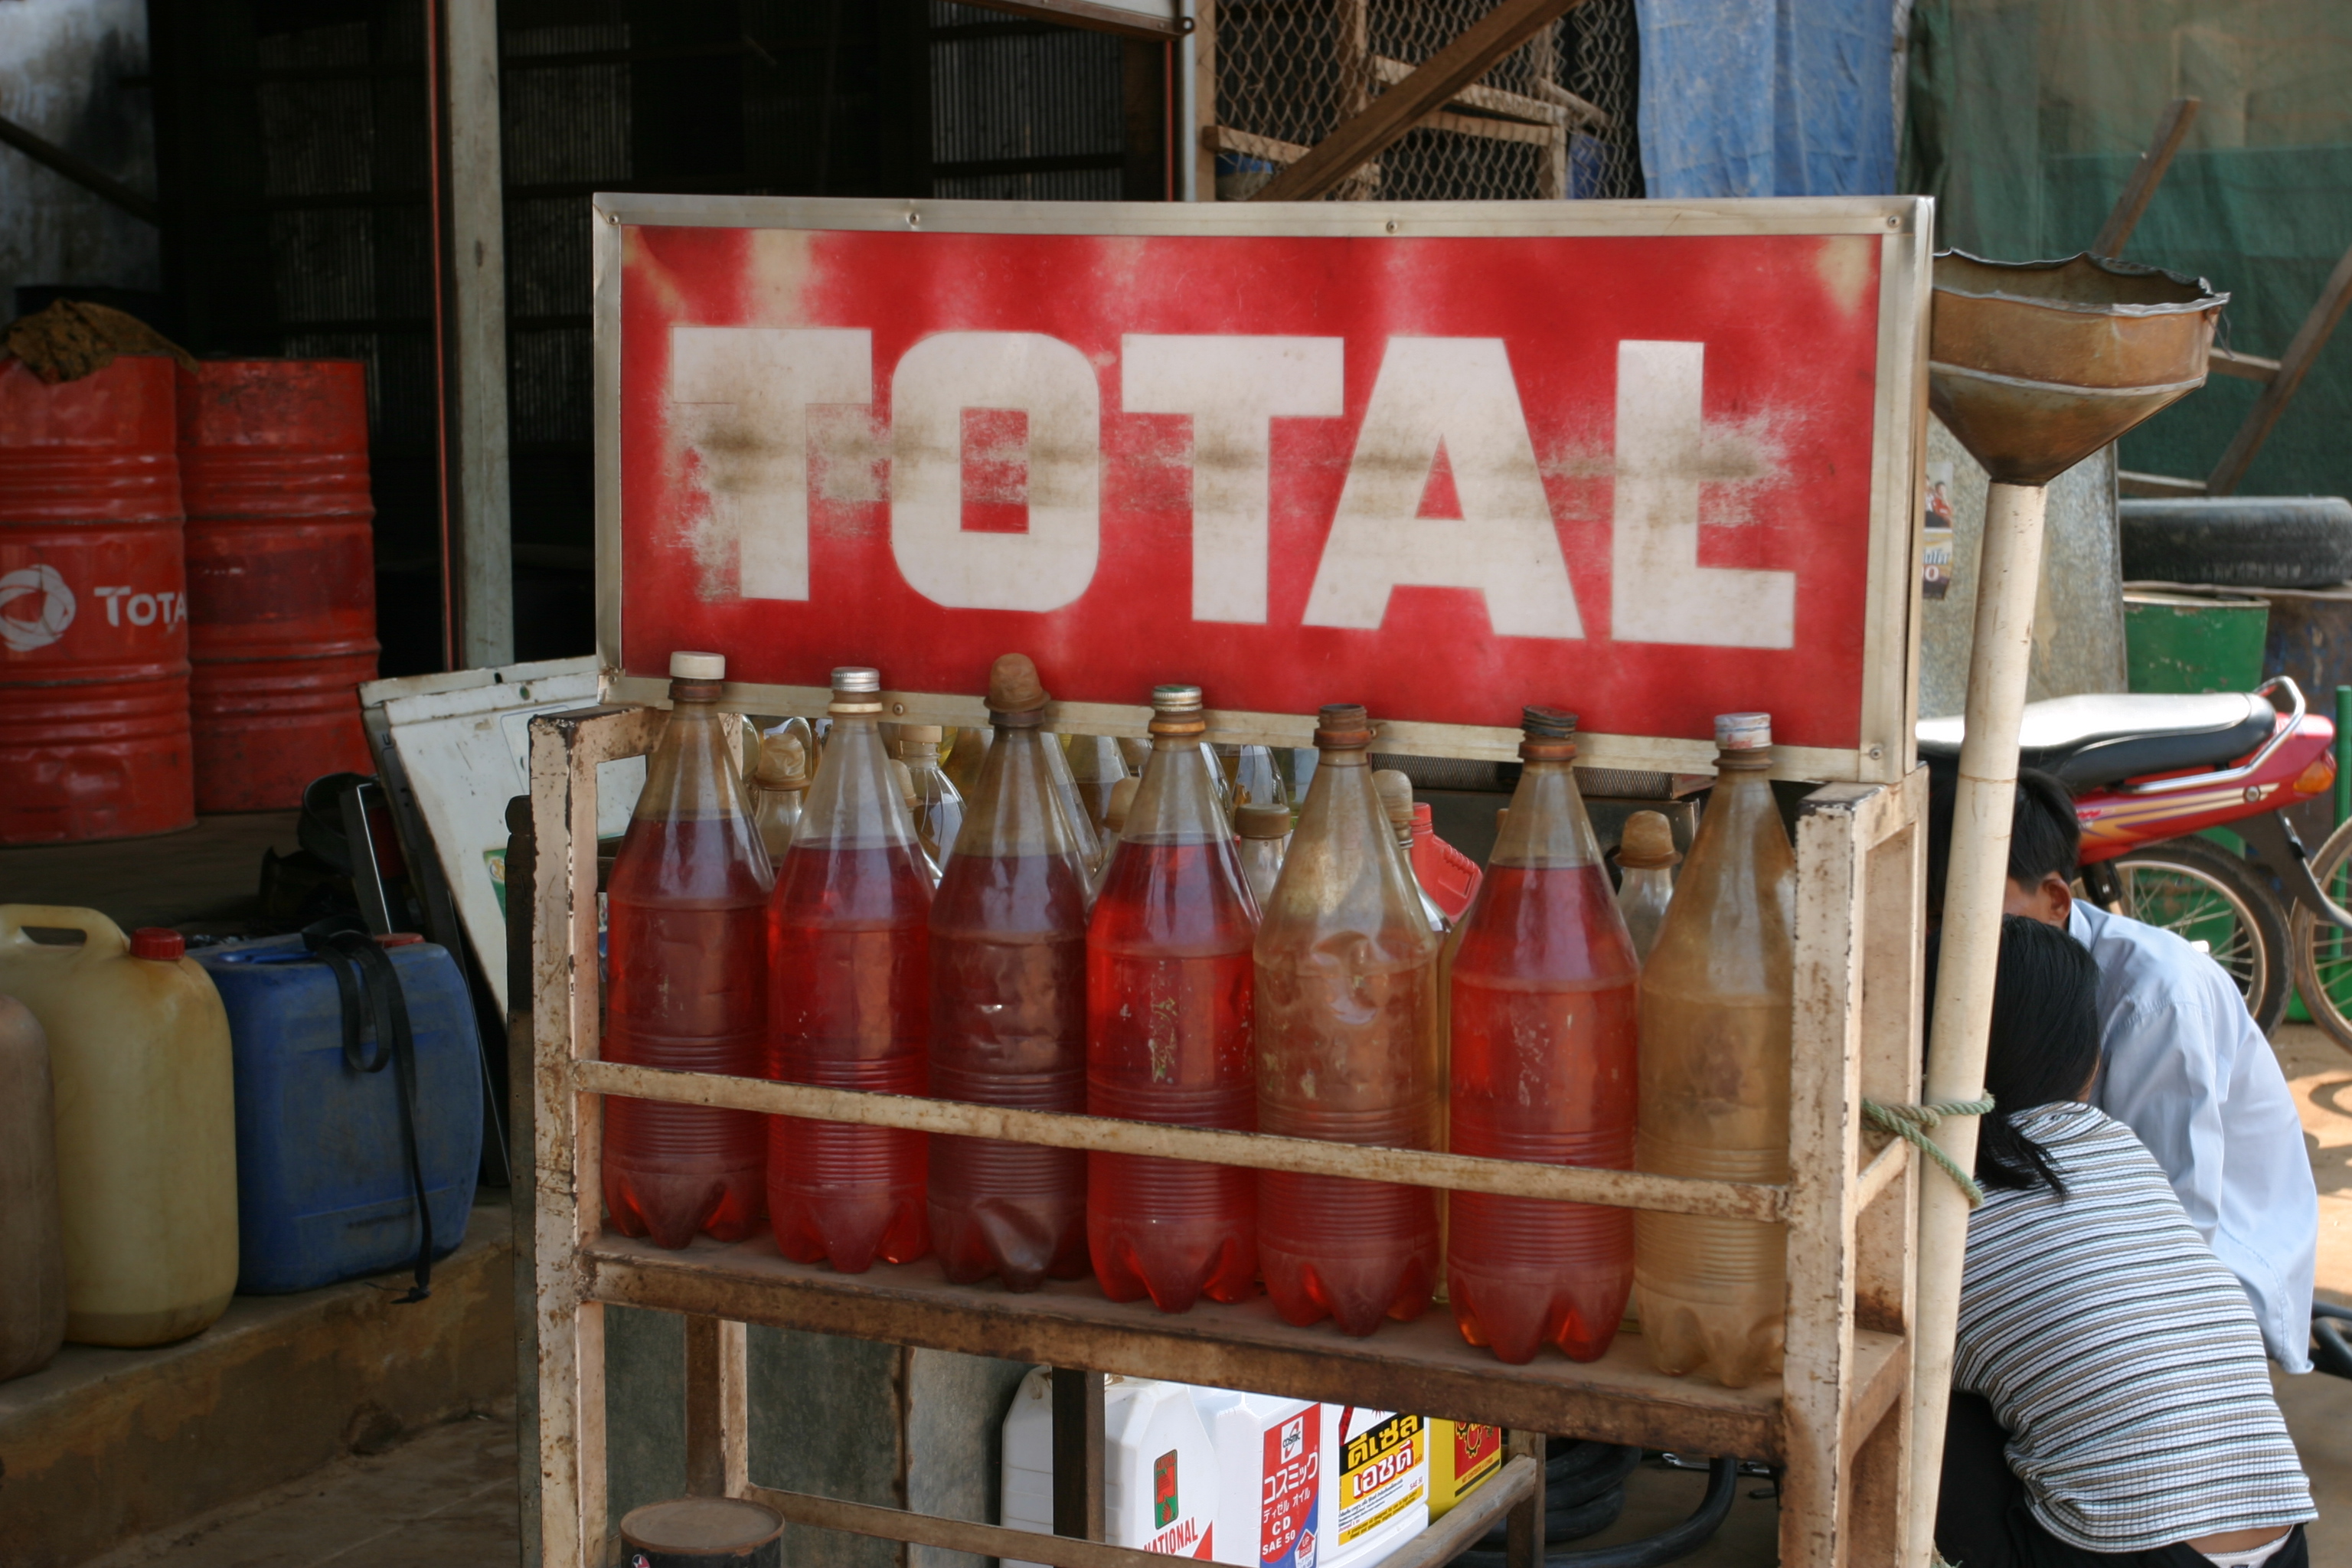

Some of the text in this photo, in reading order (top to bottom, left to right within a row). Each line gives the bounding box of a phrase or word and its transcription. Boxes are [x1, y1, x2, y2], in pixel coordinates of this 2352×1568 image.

[671, 326, 1796, 650] TOTAL
[1348, 1414, 1419, 1470] ดีเซล
[1353, 1439, 1414, 1499] เอชดี
[1263, 1452, 1318, 1505] コスミック
[1262, 1529, 1296, 1557] SAE 50
